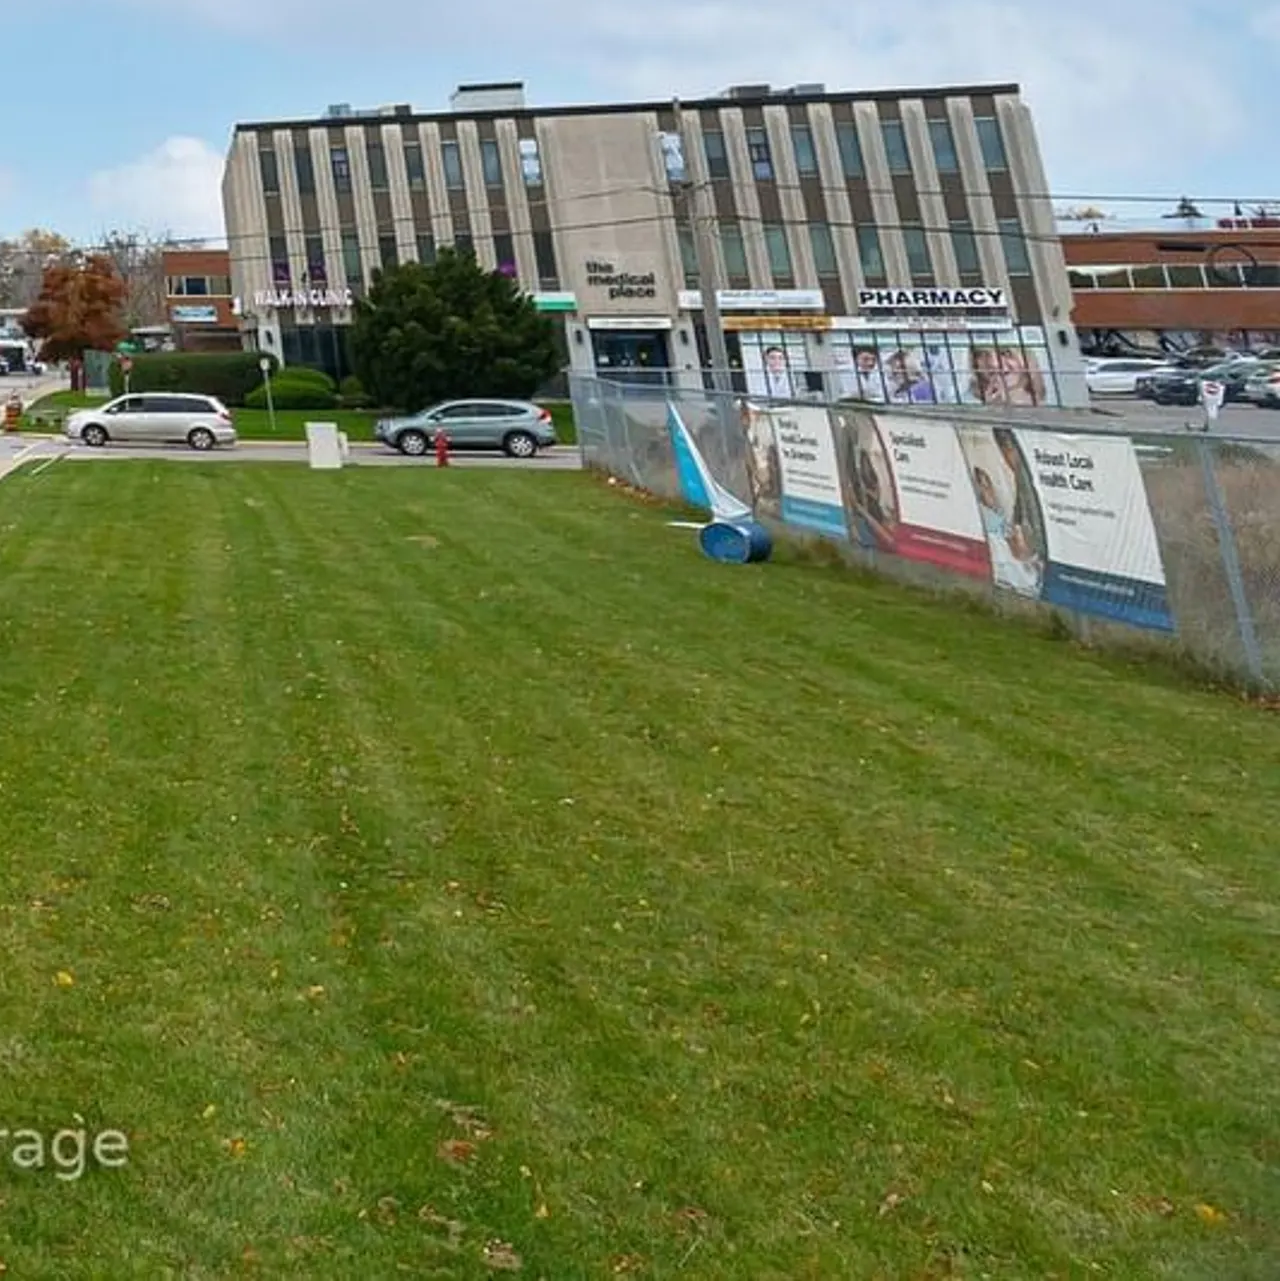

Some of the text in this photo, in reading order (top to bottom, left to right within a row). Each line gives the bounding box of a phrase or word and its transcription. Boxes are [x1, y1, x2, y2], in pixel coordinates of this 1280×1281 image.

[585, 261, 614, 273] the
[586, 272, 655, 286] medical
[608, 287, 656, 299] place
[859, 289, 1003, 306] PHARMACY
